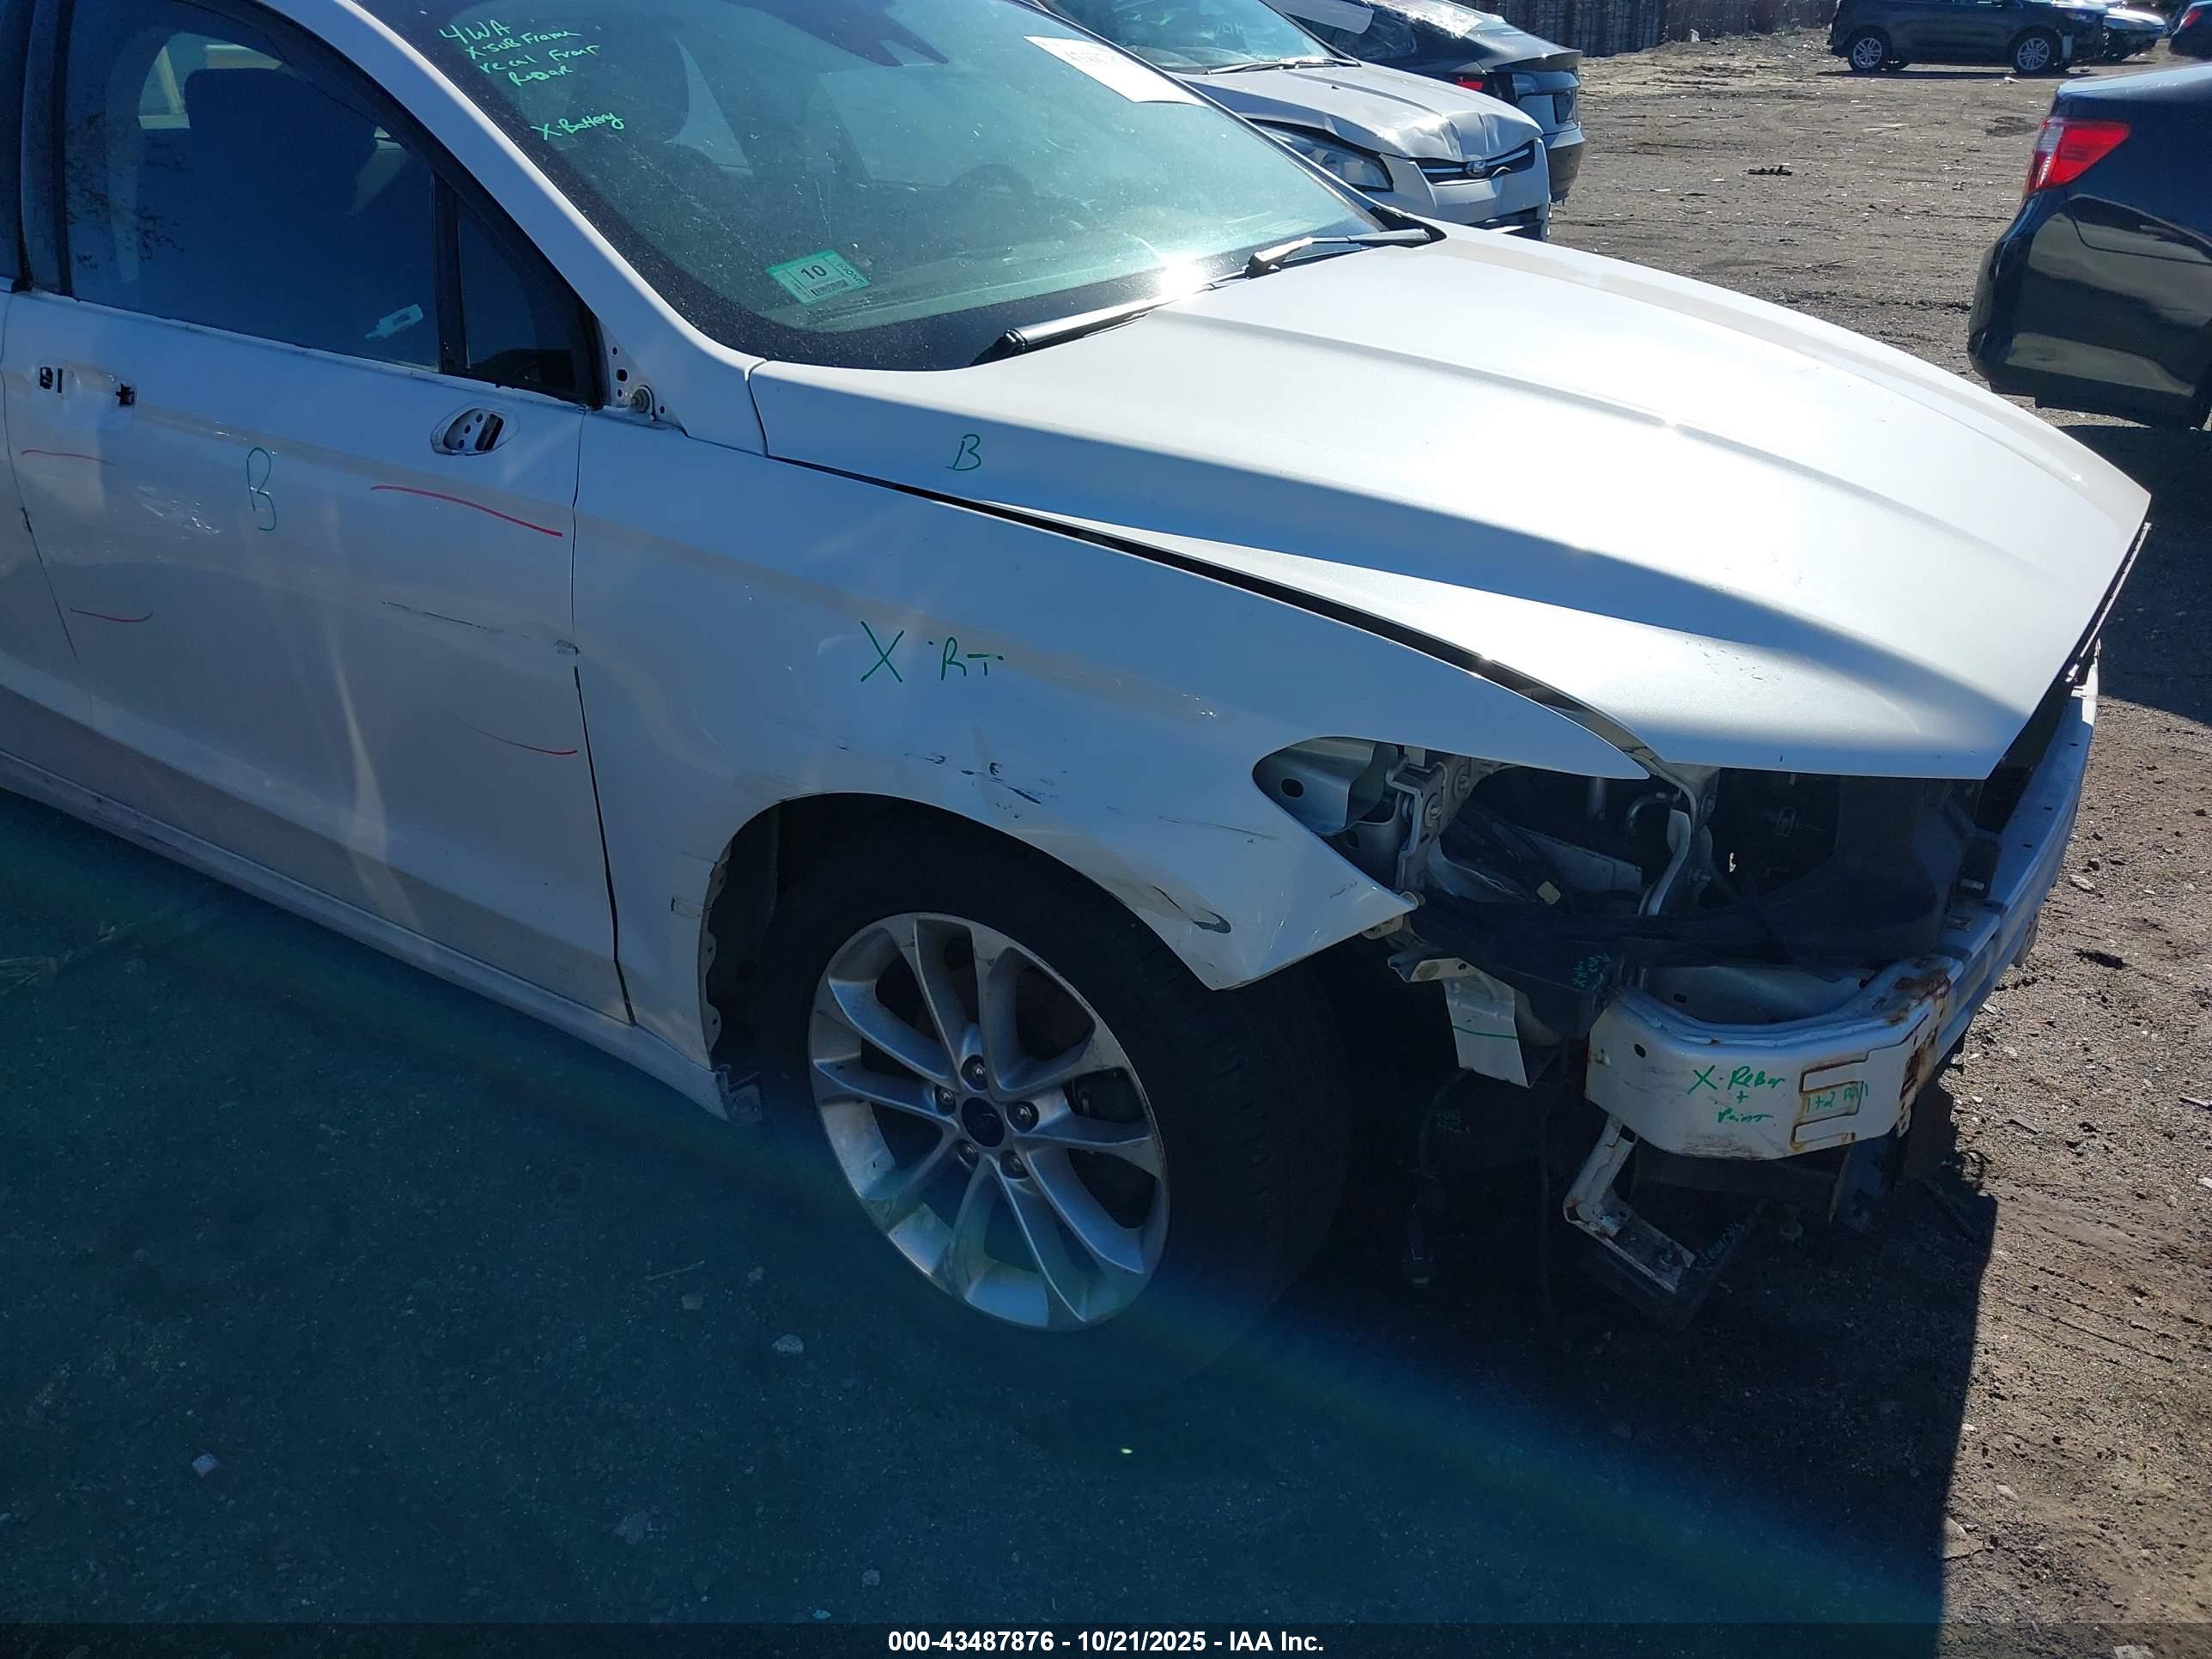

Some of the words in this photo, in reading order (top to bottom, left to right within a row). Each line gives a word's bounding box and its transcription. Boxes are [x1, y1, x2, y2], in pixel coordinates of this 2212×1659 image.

[800, 264, 828, 280] 10
[945, 433, 981, 471] B
[246, 447, 276, 532] B
[860, 621, 905, 683] X
